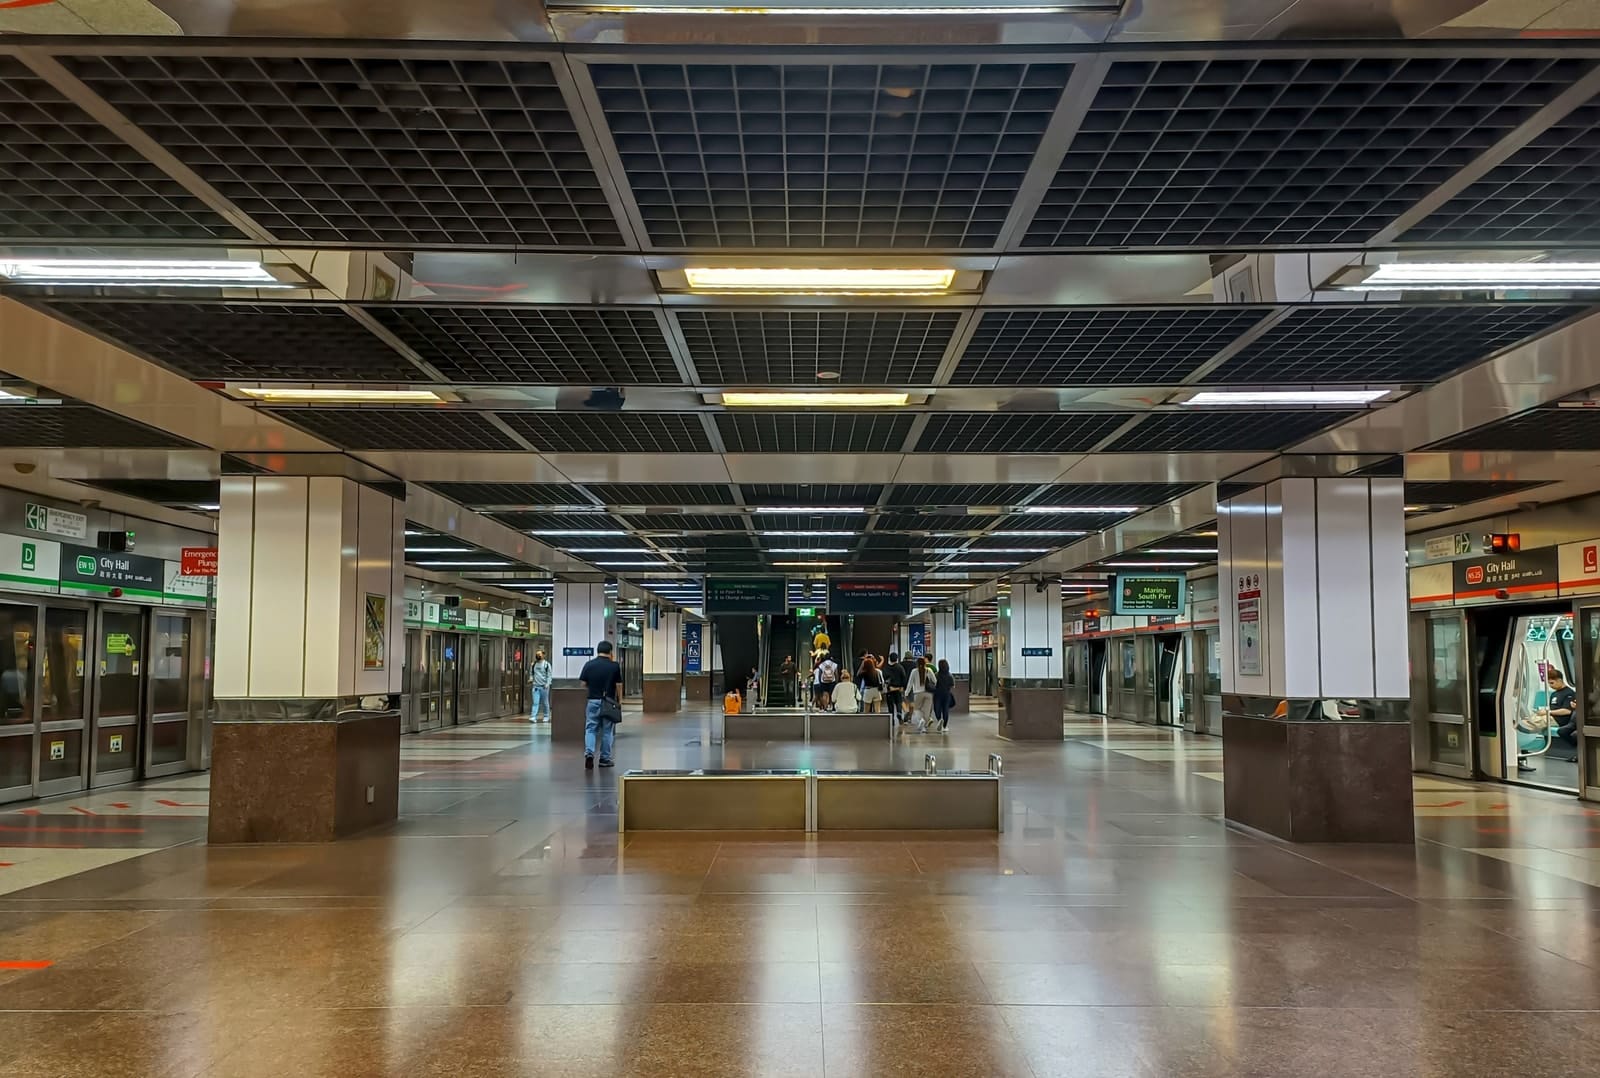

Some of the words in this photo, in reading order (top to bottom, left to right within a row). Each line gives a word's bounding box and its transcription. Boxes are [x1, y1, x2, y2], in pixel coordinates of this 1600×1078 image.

[25, 547, 33, 562] D
[1586, 550, 1595, 565] C
[100, 557, 114, 570] City
[115, 559, 130, 571] Hall
[1486, 562, 1499, 574] City
[1501, 559, 1516, 571] Hall
